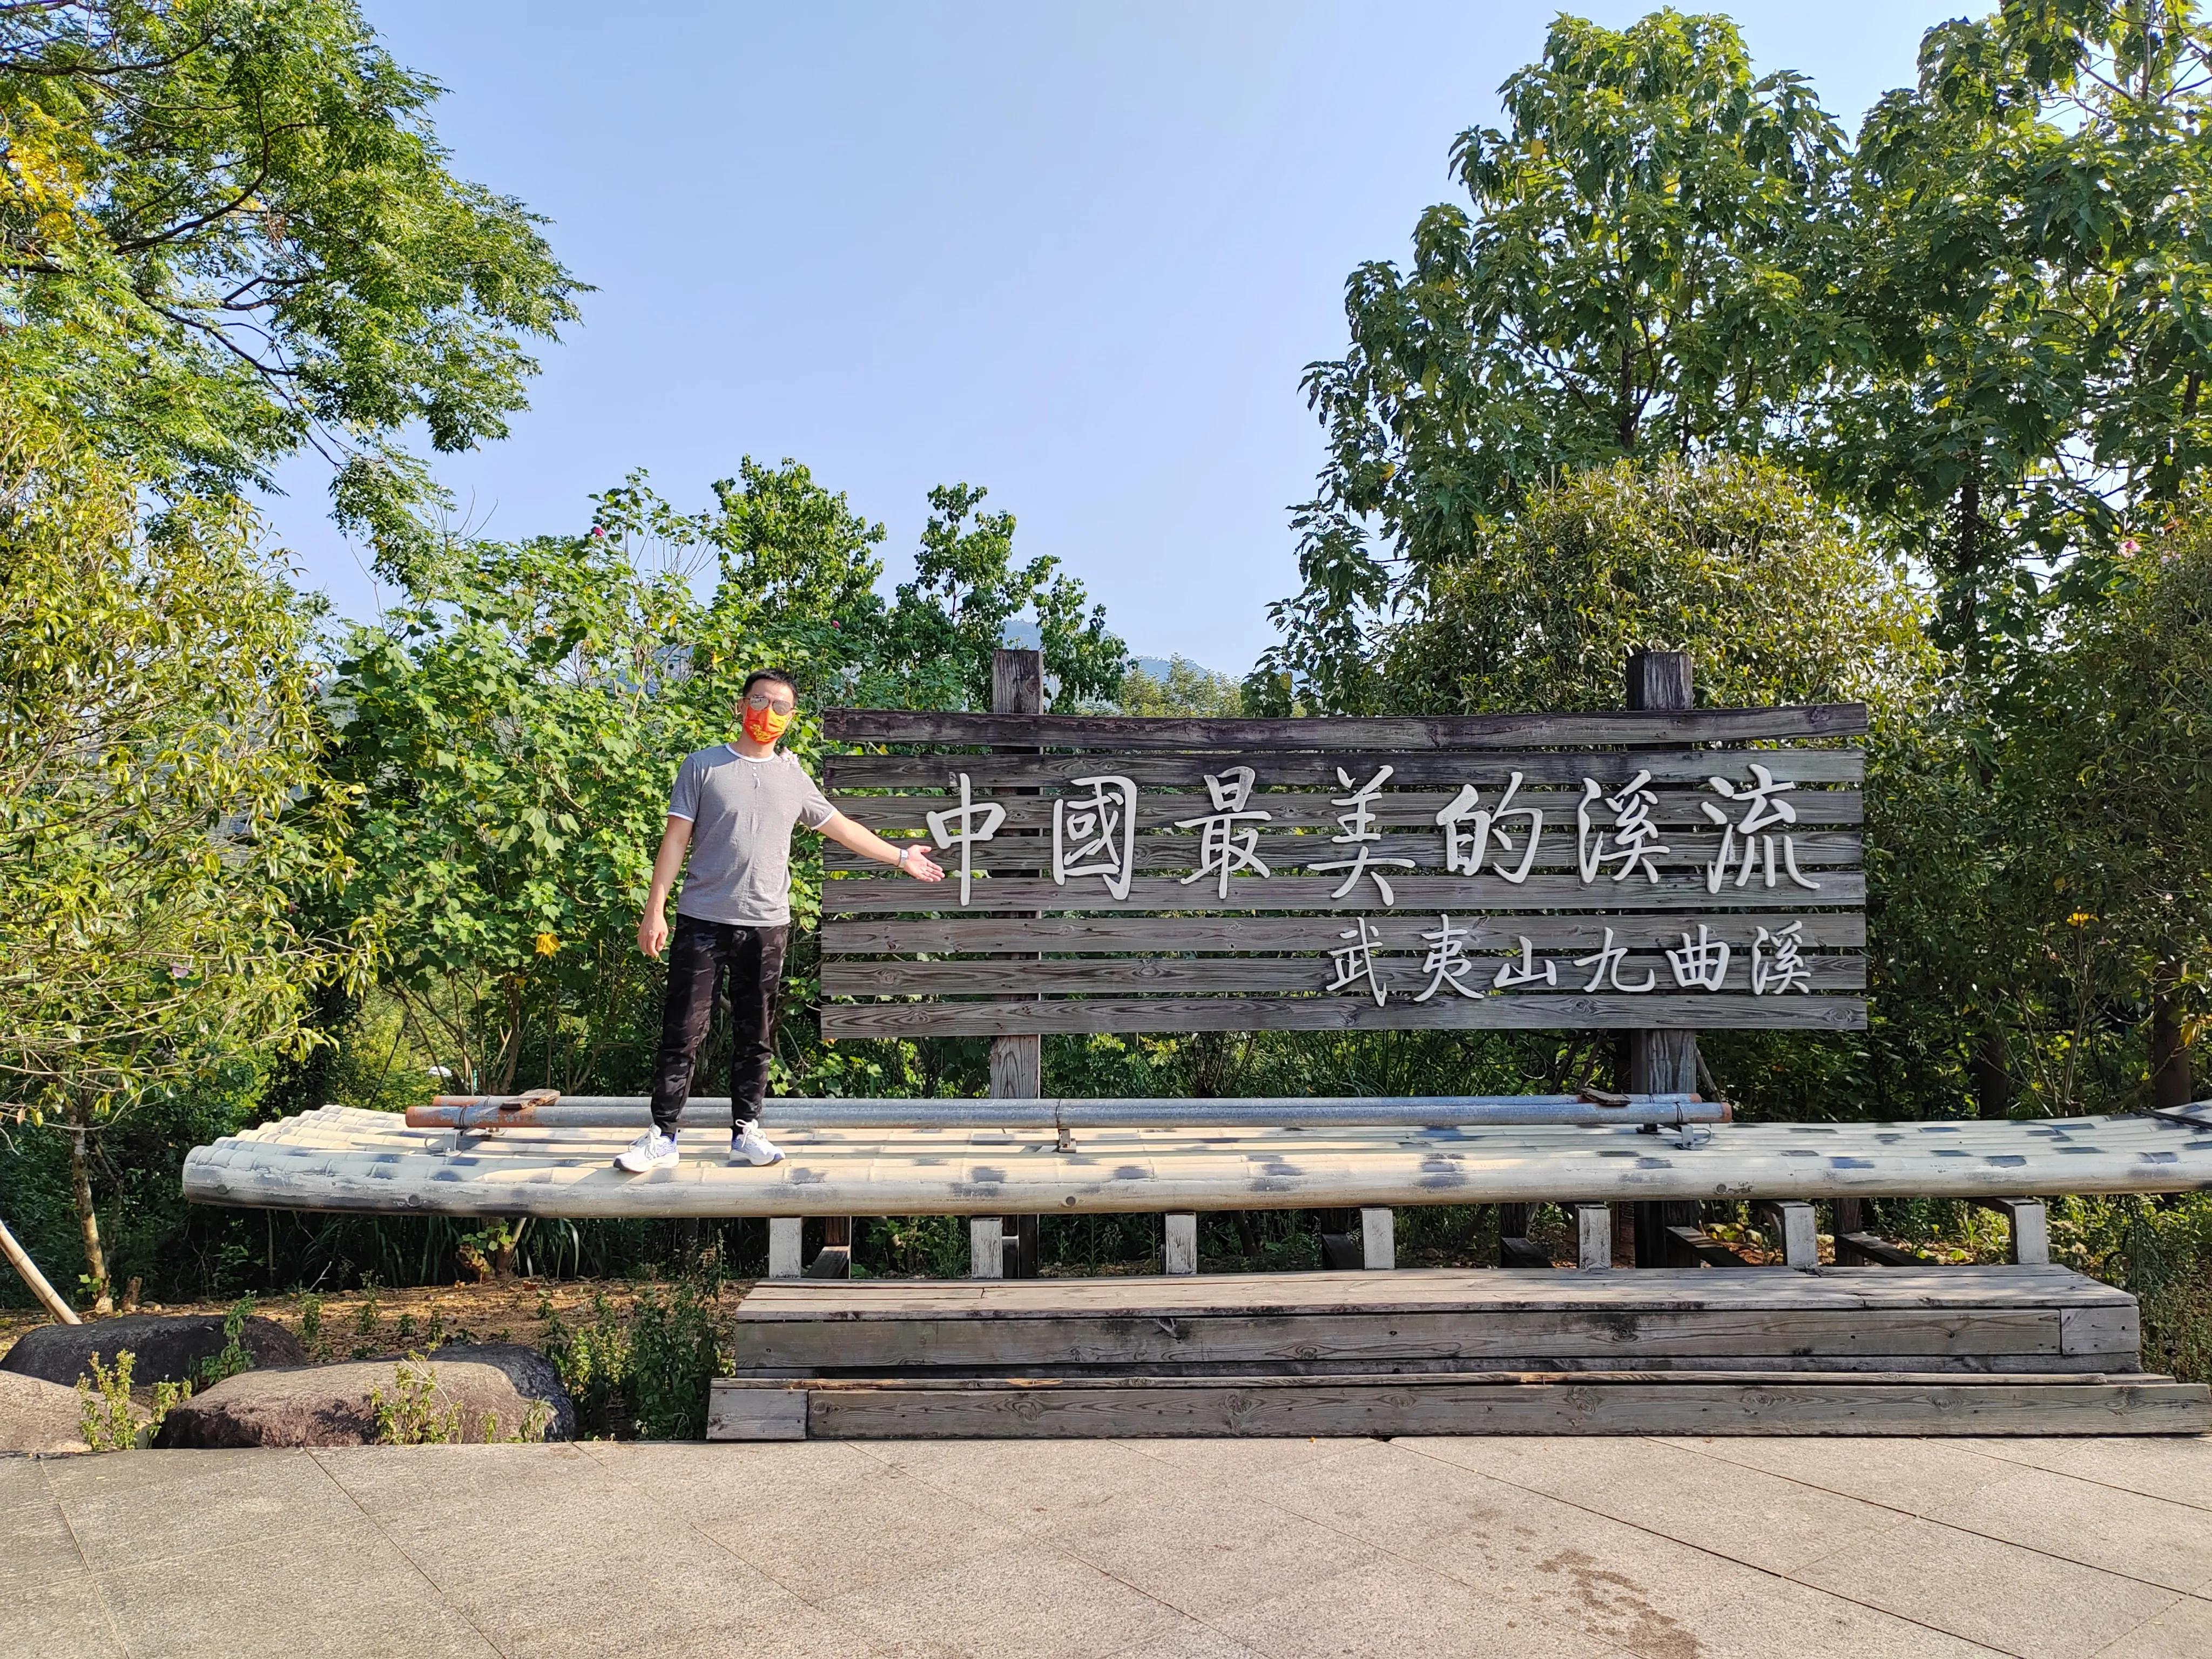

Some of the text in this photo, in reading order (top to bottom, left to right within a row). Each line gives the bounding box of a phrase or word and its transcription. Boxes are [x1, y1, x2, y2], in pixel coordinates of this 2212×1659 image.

[926, 764, 1820, 907] 中國最美的溪流
[1325, 913, 1812, 1007] 武夷山九曲溪
